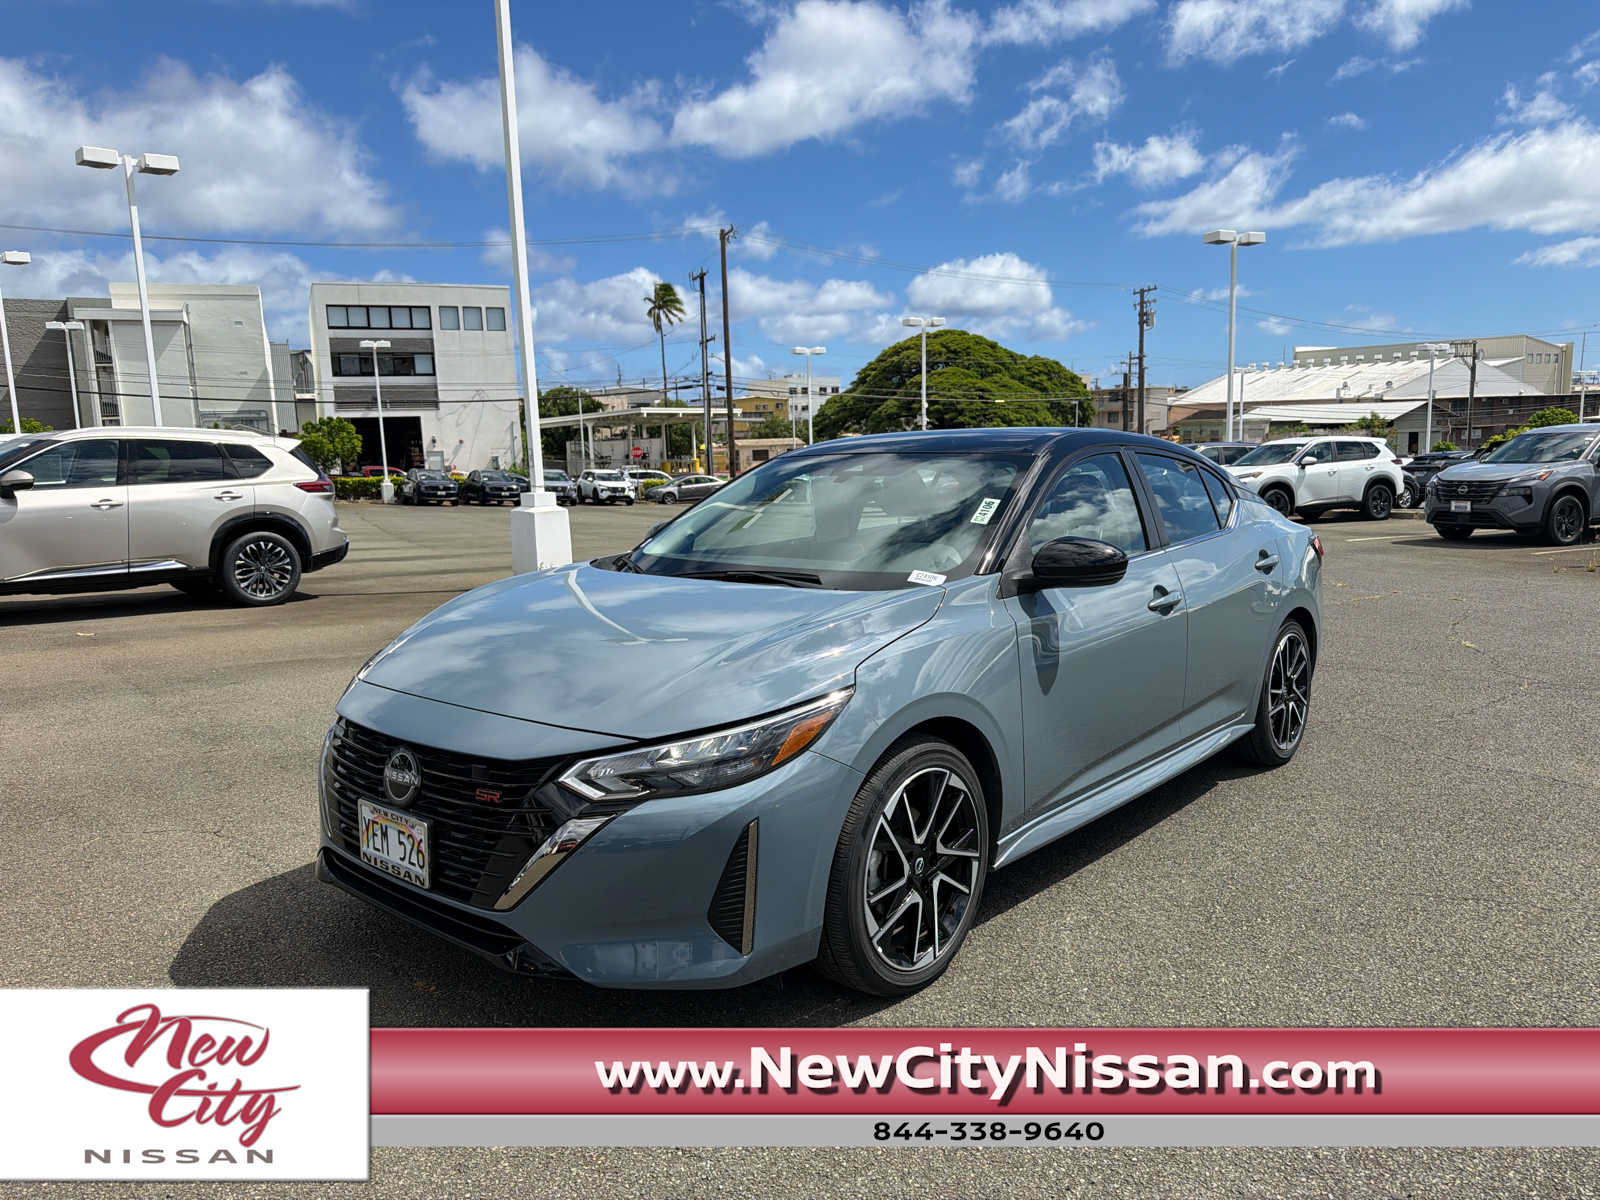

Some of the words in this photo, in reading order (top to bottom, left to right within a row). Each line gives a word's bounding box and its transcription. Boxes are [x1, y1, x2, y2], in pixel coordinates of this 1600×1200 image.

[475, 788, 501, 804] SR
[363, 816, 391, 857] YEM
[398, 829, 425, 869] 526
[362, 852, 425, 886] NISSAN
